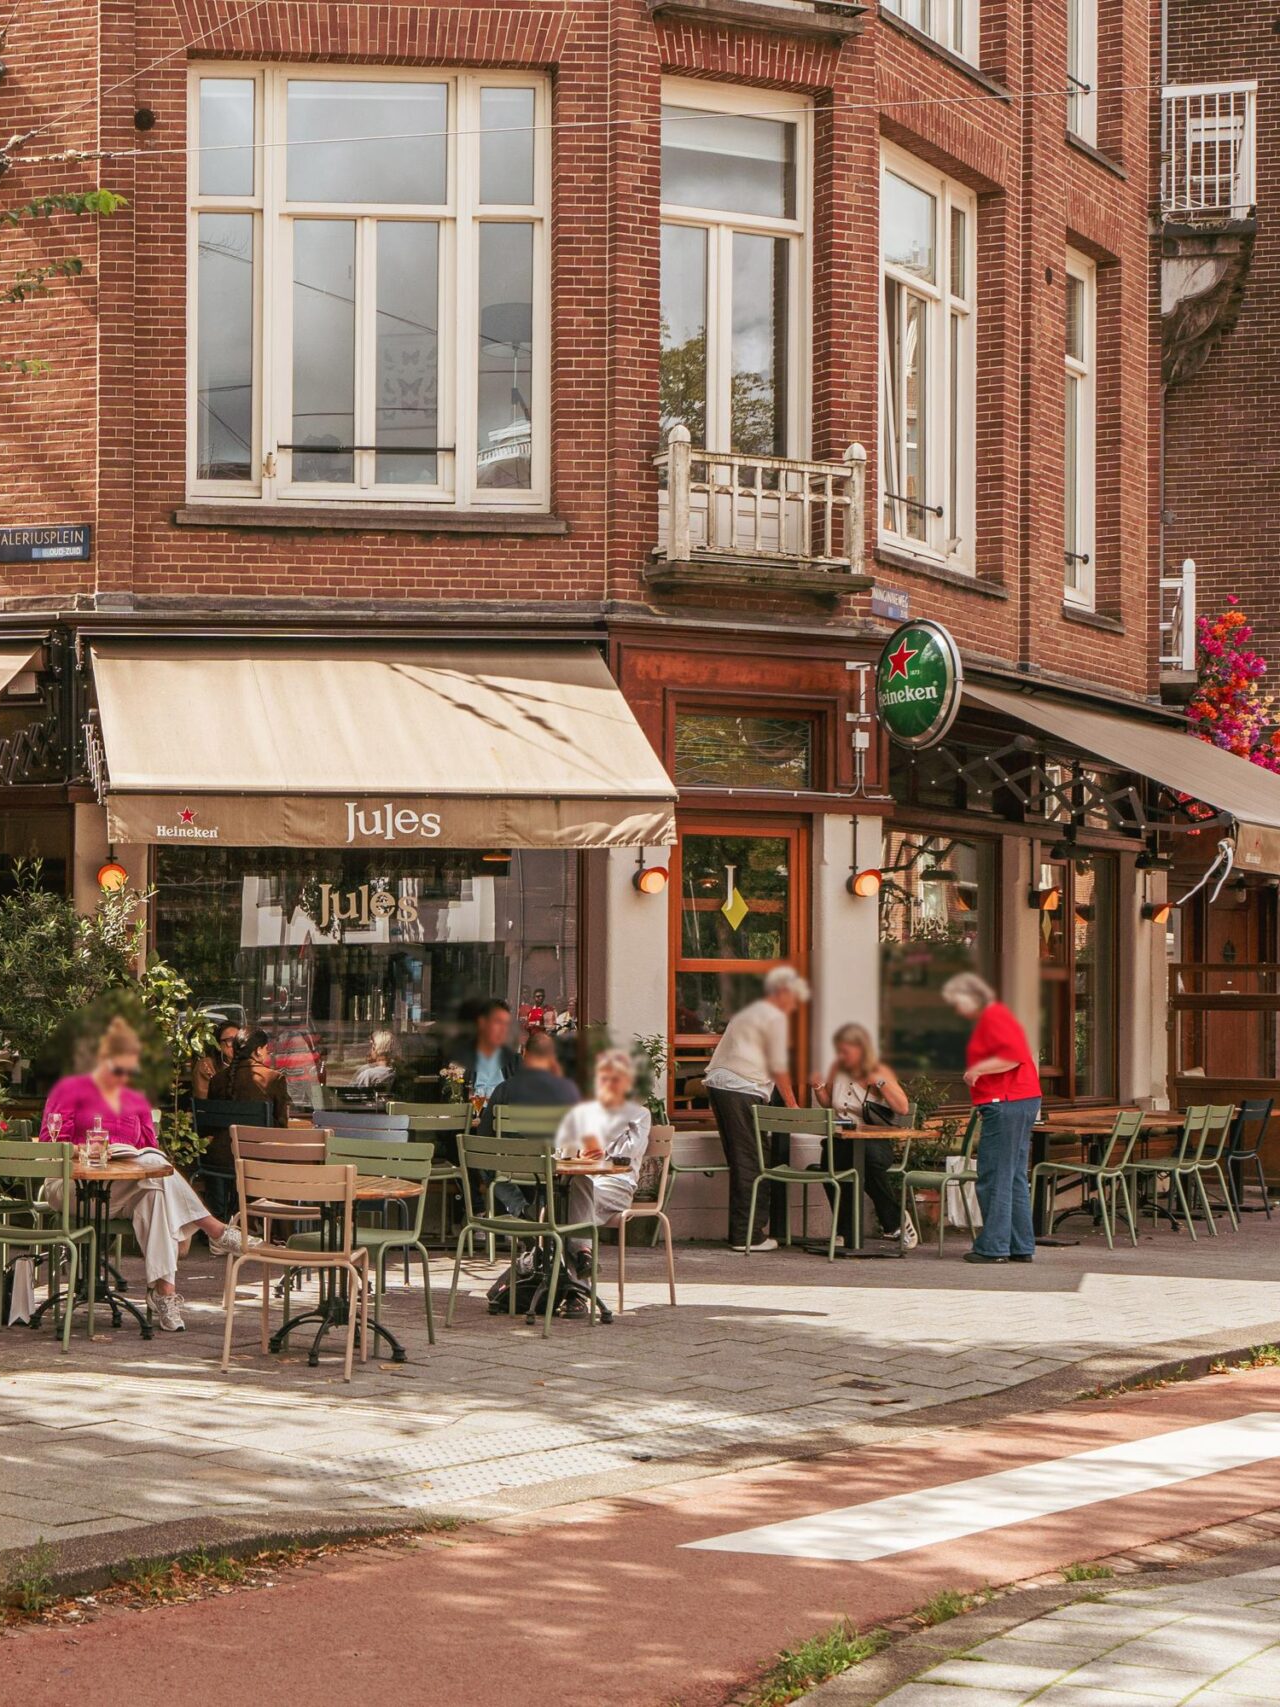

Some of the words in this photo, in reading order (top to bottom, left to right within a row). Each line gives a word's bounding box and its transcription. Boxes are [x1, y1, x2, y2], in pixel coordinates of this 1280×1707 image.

[157, 825, 218, 838] Heineken
[345, 802, 441, 843] Jules
[319, 884, 418, 927] Jules
